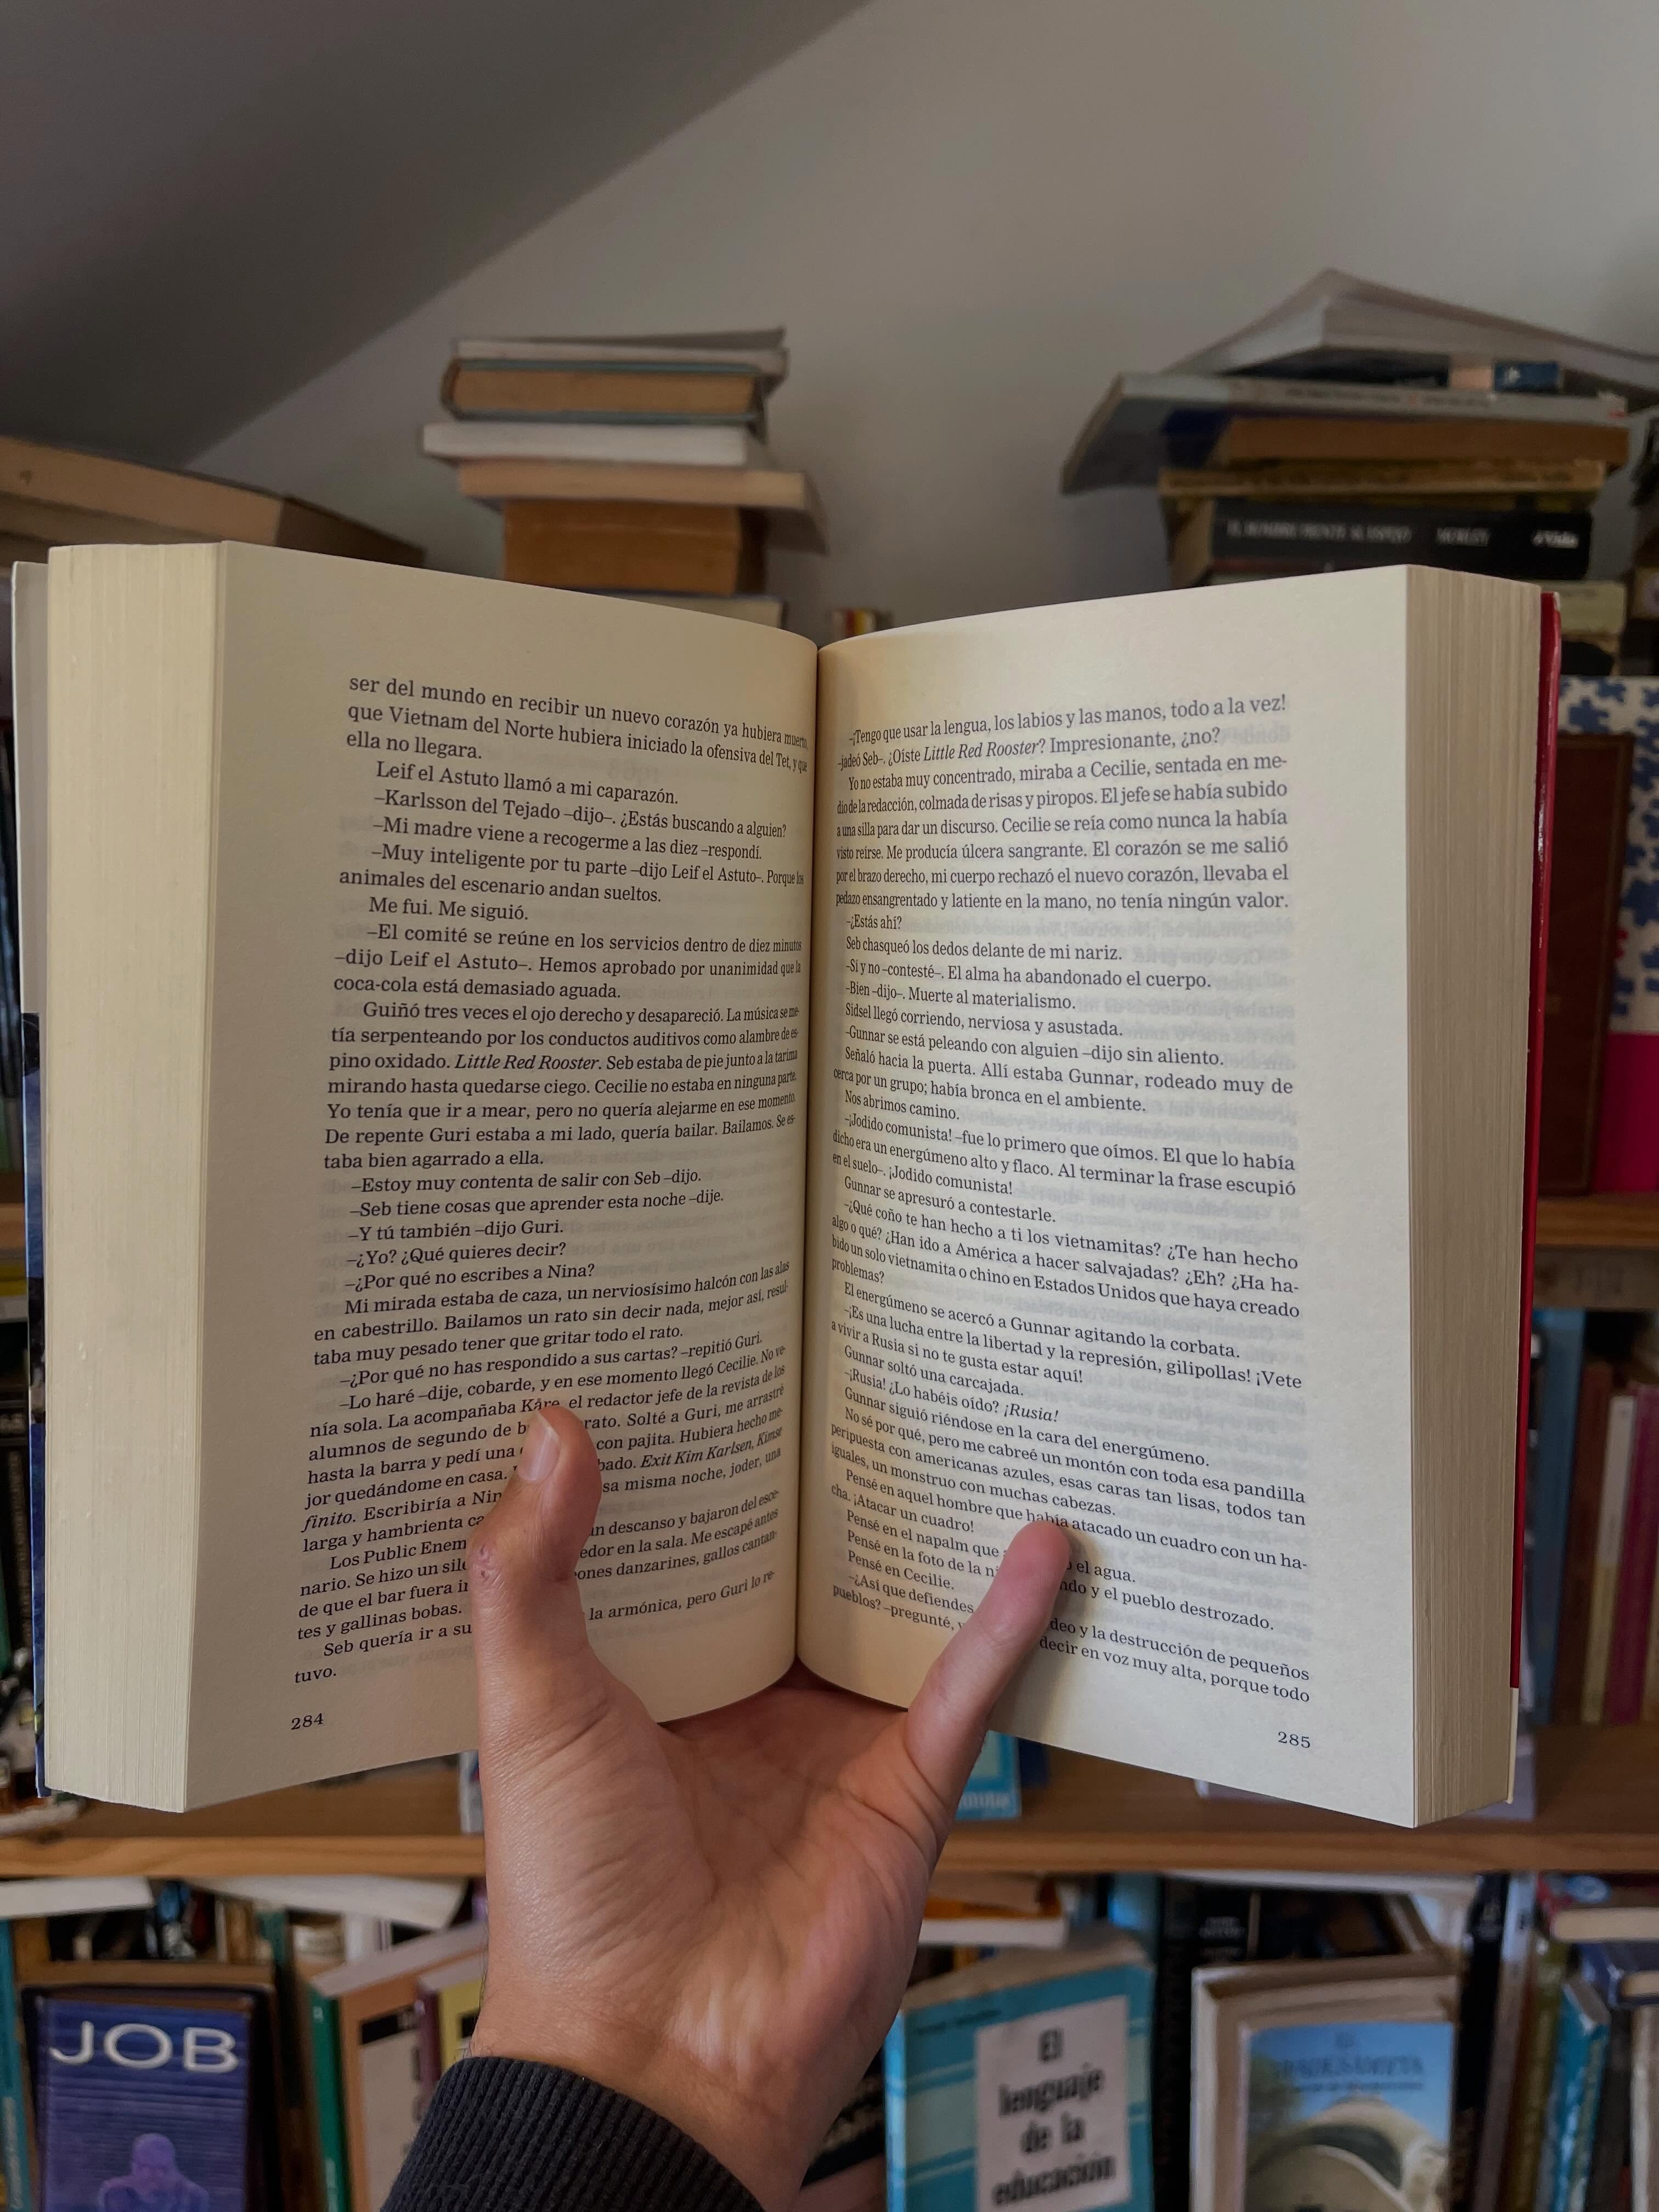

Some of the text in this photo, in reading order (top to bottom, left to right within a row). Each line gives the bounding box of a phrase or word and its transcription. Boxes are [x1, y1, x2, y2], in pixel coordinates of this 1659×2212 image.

[349, 678, 808, 750] ser del mundo en recibir un nuevo corazón ya hubiera muerto,
[883, 728, 901, 743] que
[903, 725, 928, 738] usar
[930, 720, 941, 736] la
[943, 719, 991, 736] lengua,
[994, 715, 1014, 731] los
[1017, 712, 1063, 729] labios
[1066, 713, 1076, 729] y
[1079, 708, 1102, 724] las
[1105, 707, 1166, 723] manos,
[1171, 699, 1209, 718] todo
[1214, 702, 1224, 715] a
[1228, 697, 1245, 714] la
[1250, 693, 1285, 712] vez!
[472, 797, 498, 814] del
[502, 799, 560, 820] Tejado
[620, 810, 668, 828] ¿Estás
[672, 814, 734, 834] buscando
[737, 823, 744, 834] a
[746, 821, 787, 839] alguien?
[339, 868, 661, 902] animales del escenario andan sueltos.
[880, 915, 902, 930] ahí?
[846, 936, 1122, 960] Seb chasqueó los dedos delante de mi nariz.
[334, 976, 620, 1000] coca-cola está demasiado aguada.
[845, 1002, 1123, 1036] Sidsel llegó corriendo, nerviosa y asustada.
[329, 1048, 798, 1071] pino oxidado. Little Red Rooster. Seb estaba de pie junto a la tarima
[845, 1089, 960, 1120] Nos abrimos camino.
[844, 1176, 1056, 1223] Gunnar se apresuró a contestarle.
[376, 1225, 396, 1240] tú
[399, 1222, 471, 1239] también
[521, 1219, 563, 1234] Guri.
[400, 1246, 444, 1266] ¿Qué
[448, 1245, 512, 1263] quieres
[516, 1242, 567, 1257] decir?
[844, 1281, 1240, 1358] El energúmeno se acercó a Gunnar agitando la corbata.
[313, 1325, 683, 1365] taba muy pesado tener que gritar todo el rato.
[889, 1381, 911, 1396] ¿Lo
[913, 1385, 958, 1407] habéis
[961, 1397, 999, 1413] oído?
[1003, 1403, 1059, 1423] ¡Rusia!
[831, 1444, 1115, 1516] iguales, un monstruo con muchas cabezas.
[848, 1549, 954, 1590] Pensé en Cecilie.
[323, 1639, 354, 1656] Seb
[359, 1630, 413, 1652] quería
[419, 1627, 434, 1640] ir
[438, 1627, 448, 1638] a
[588, 1607, 603, 1621] la
[608, 1599, 682, 1618] armónica,
[686, 1592, 716, 1609] pero
[720, 1578, 748, 1598] Guri
[751, 1576, 761, 1589] lo
[763, 1571, 775, 1583] re-
[882, 1584, 906, 1598] que
[909, 1588, 974, 1614] defiendes
[1079, 1626, 1088, 1638] y
[1092, 1625, 1107, 1640] la
[1109, 1629, 1203, 1660] destrucción
[1207, 1649, 1226, 1664] de
[1229, 1656, 1310, 1680] pequeños
[294, 1668, 337, 1684] tuvo.
[290, 1712, 324, 1730] 284
[1278, 1731, 1311, 1748] 285
[50, 2021, 239, 2073] JOB
[1039, 2027, 1063, 2063] El
[998, 2062, 1105, 2118] lenguaje
[1021, 2112, 1086, 2154] de la
